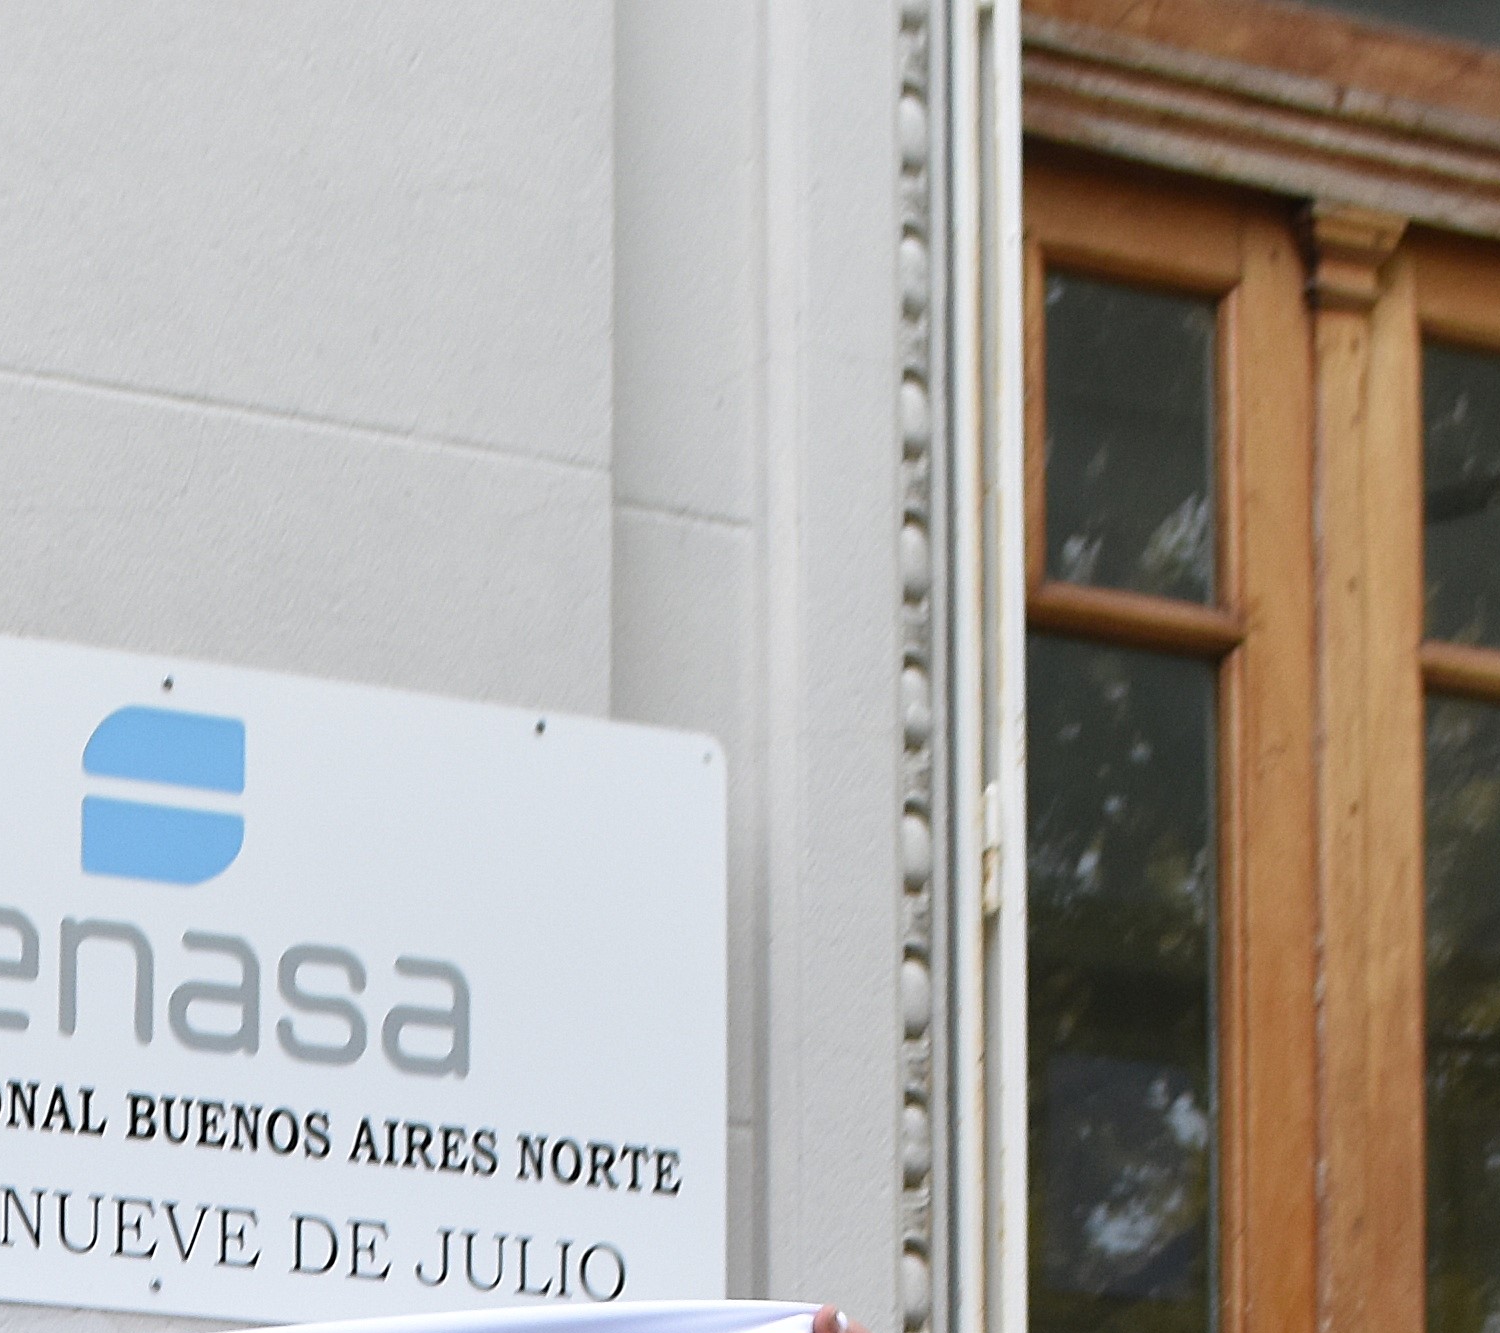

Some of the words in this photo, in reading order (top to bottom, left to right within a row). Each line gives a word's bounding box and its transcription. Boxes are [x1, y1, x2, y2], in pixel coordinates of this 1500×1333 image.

[123, 1089, 333, 1162] BUENOS
[346, 1114, 501, 1180] AIRES
[513, 1131, 685, 1198] NORTE
[287, 1212, 393, 1283] DE
[413, 1226, 628, 1304] JULIO
